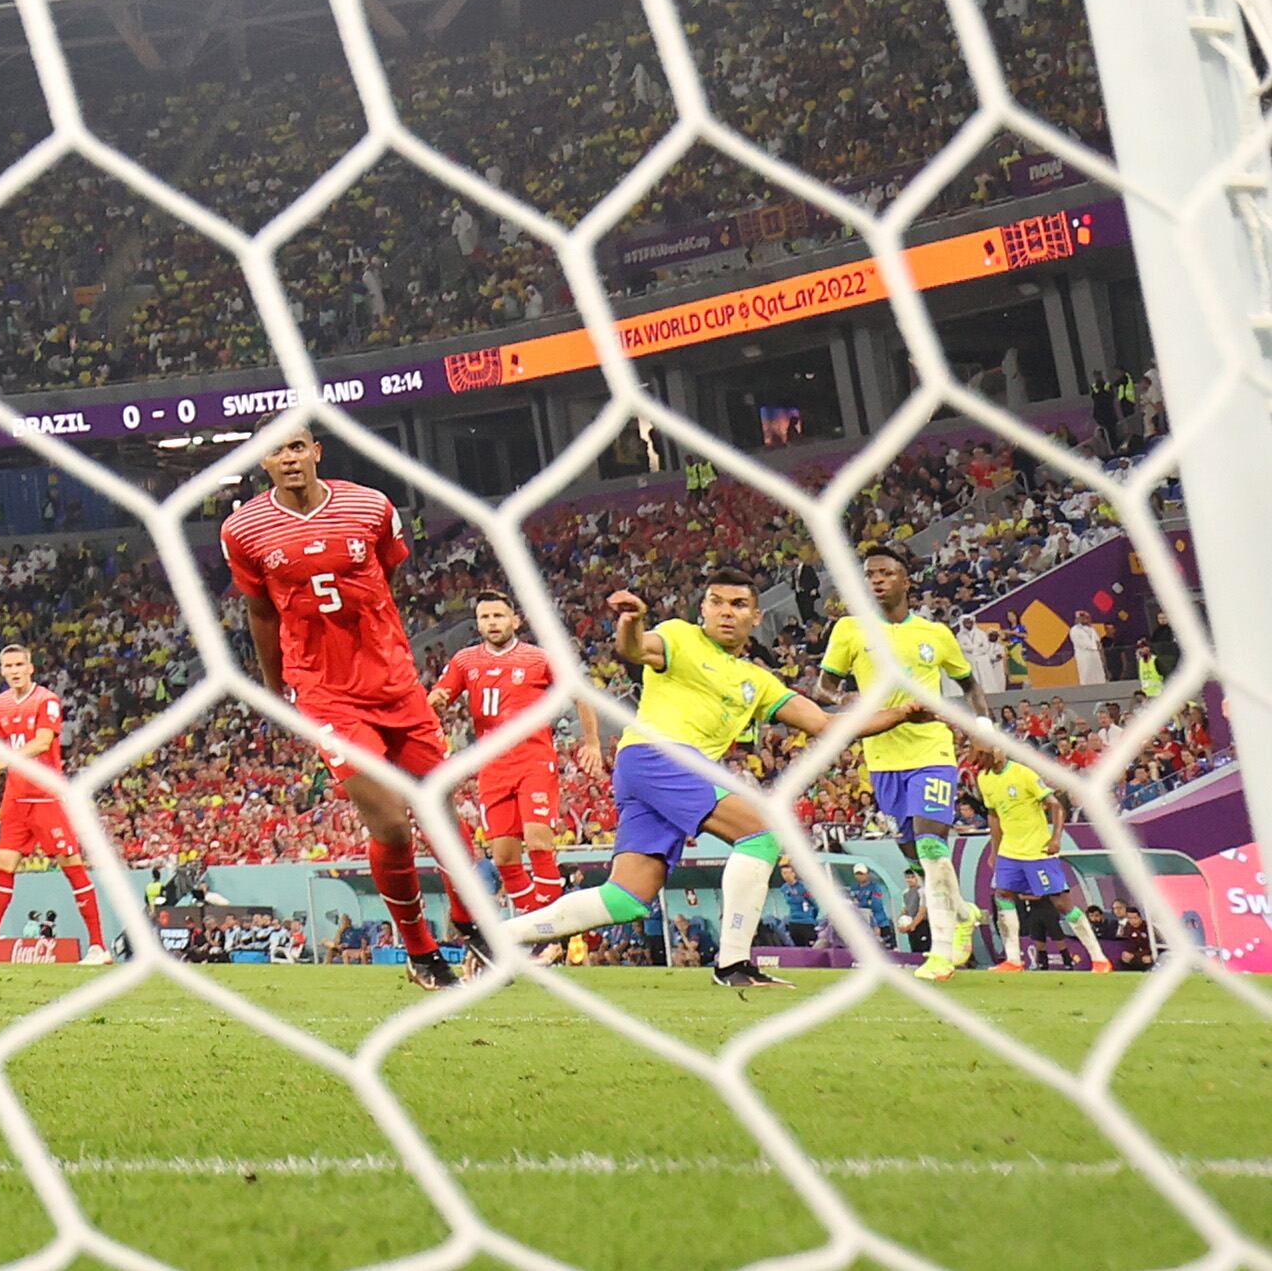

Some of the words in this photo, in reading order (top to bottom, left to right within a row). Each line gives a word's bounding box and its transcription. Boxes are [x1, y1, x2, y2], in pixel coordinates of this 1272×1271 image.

[644, 314, 701, 344] WORLD
[704, 305, 735, 329] CUP
[13, 413, 91, 438] BRAZIL
[123, 405, 141, 430] 0
[178, 399, 196, 425] 0
[380, 370, 423, 396] 82:14
[311, 573, 342, 613] 5
[482, 687, 500, 717] 11
[924, 777, 952, 806] 20
